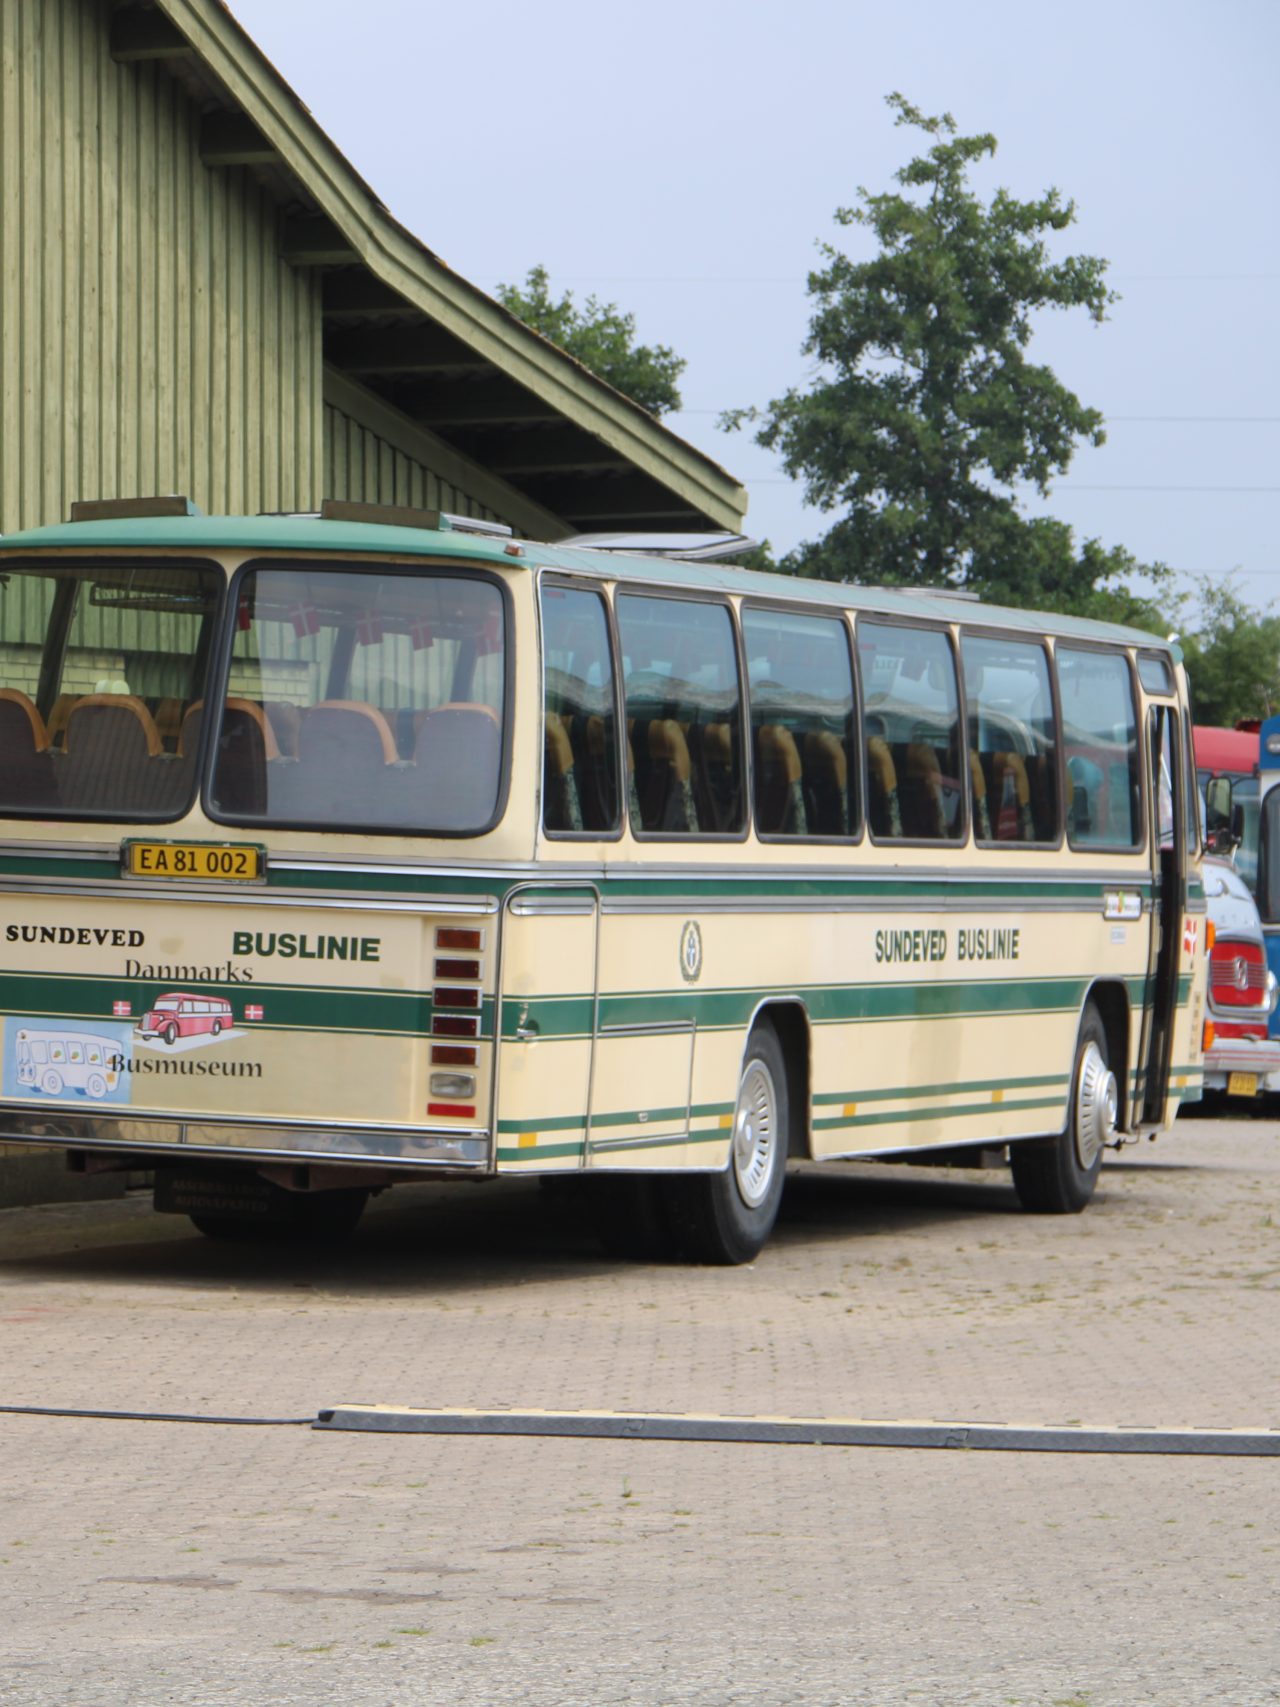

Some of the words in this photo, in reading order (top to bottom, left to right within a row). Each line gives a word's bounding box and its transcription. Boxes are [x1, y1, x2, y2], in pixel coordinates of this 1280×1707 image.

[140, 848, 168, 870] EA
[174, 850, 198, 872] 81
[206, 851, 247, 874] 002
[6, 924, 145, 947] SUNDEVED
[232, 931, 381, 962] BUSLINIE
[875, 929, 947, 963] SUNDEVED
[958, 928, 1020, 961] BUSLINIE
[125, 959, 253, 982] Danmarks
[111, 1053, 263, 1078] Busmuseum
